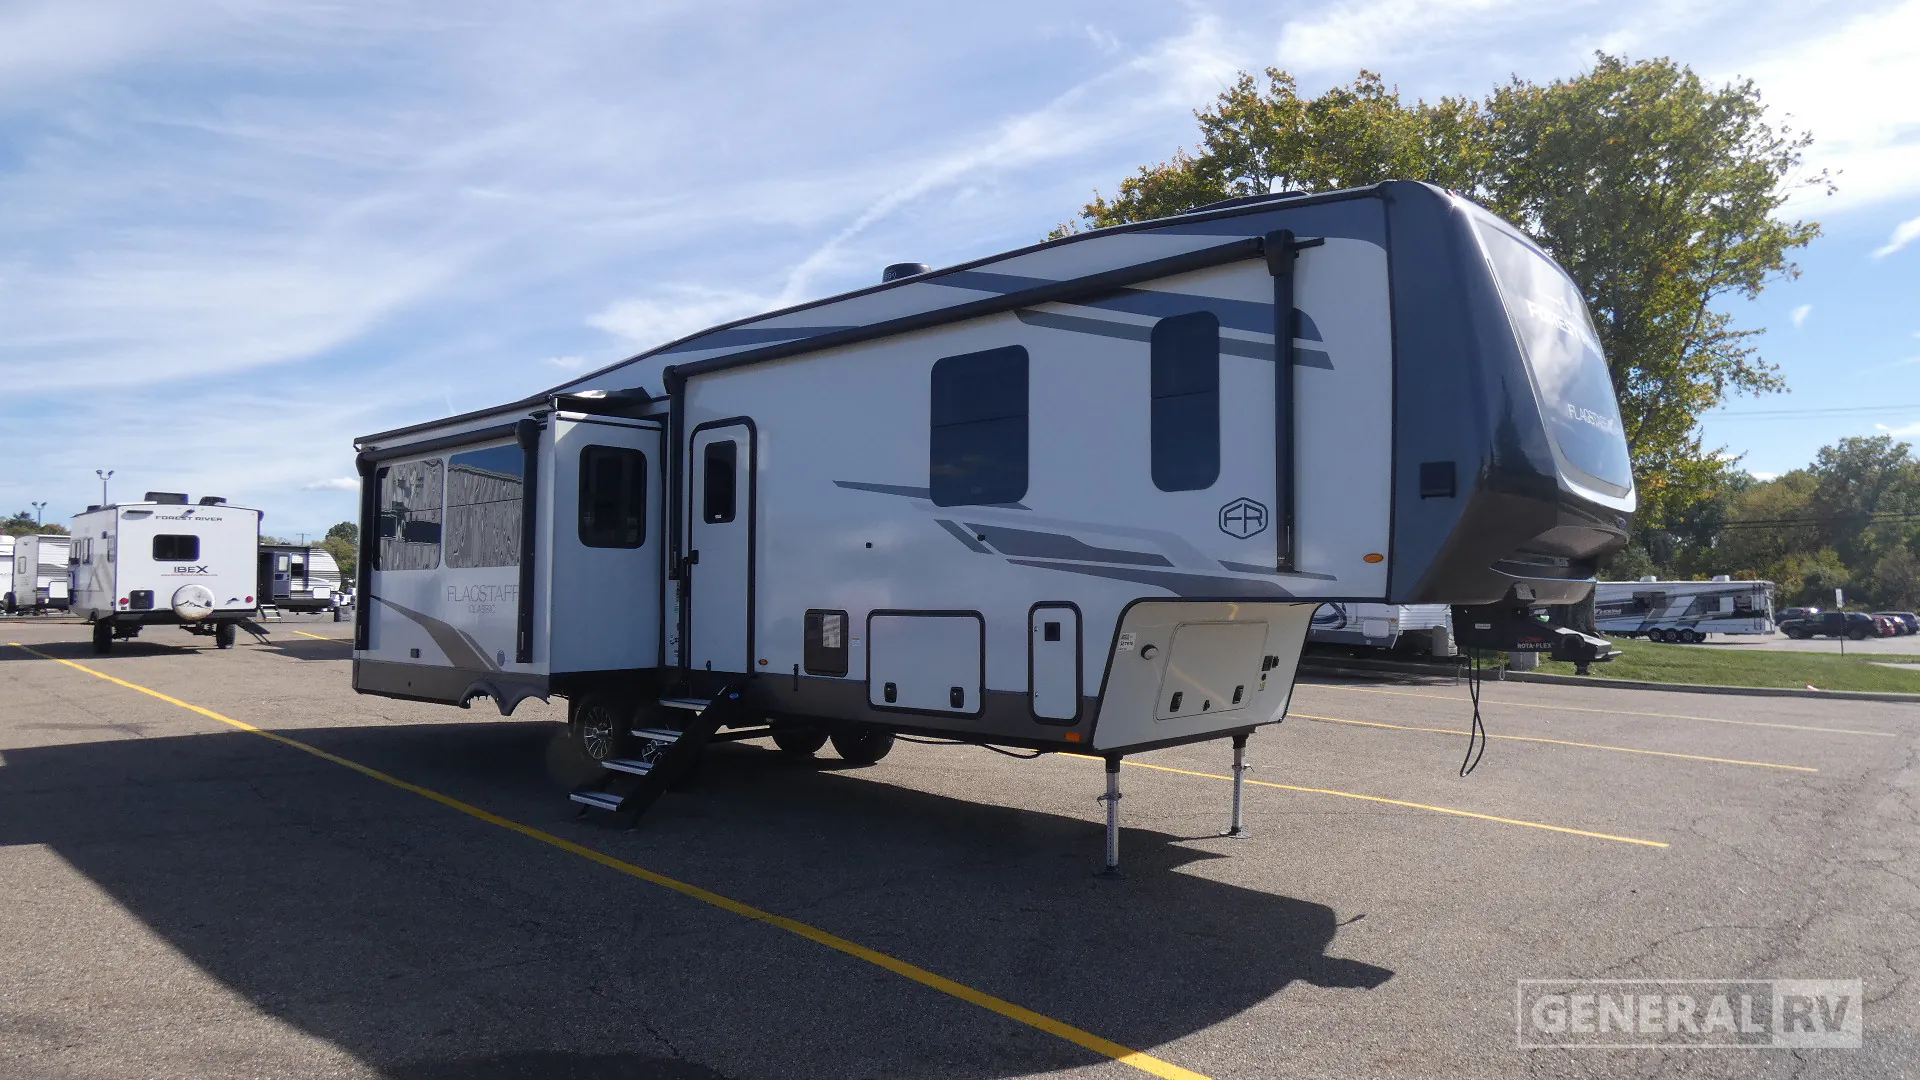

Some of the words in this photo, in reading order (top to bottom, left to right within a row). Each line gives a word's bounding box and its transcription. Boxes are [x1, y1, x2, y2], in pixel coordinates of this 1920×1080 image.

[173, 565, 209, 573] IBEX
[447, 584, 519, 602] FLAGSTAFF
[468, 604, 496, 613] CLASSIC
